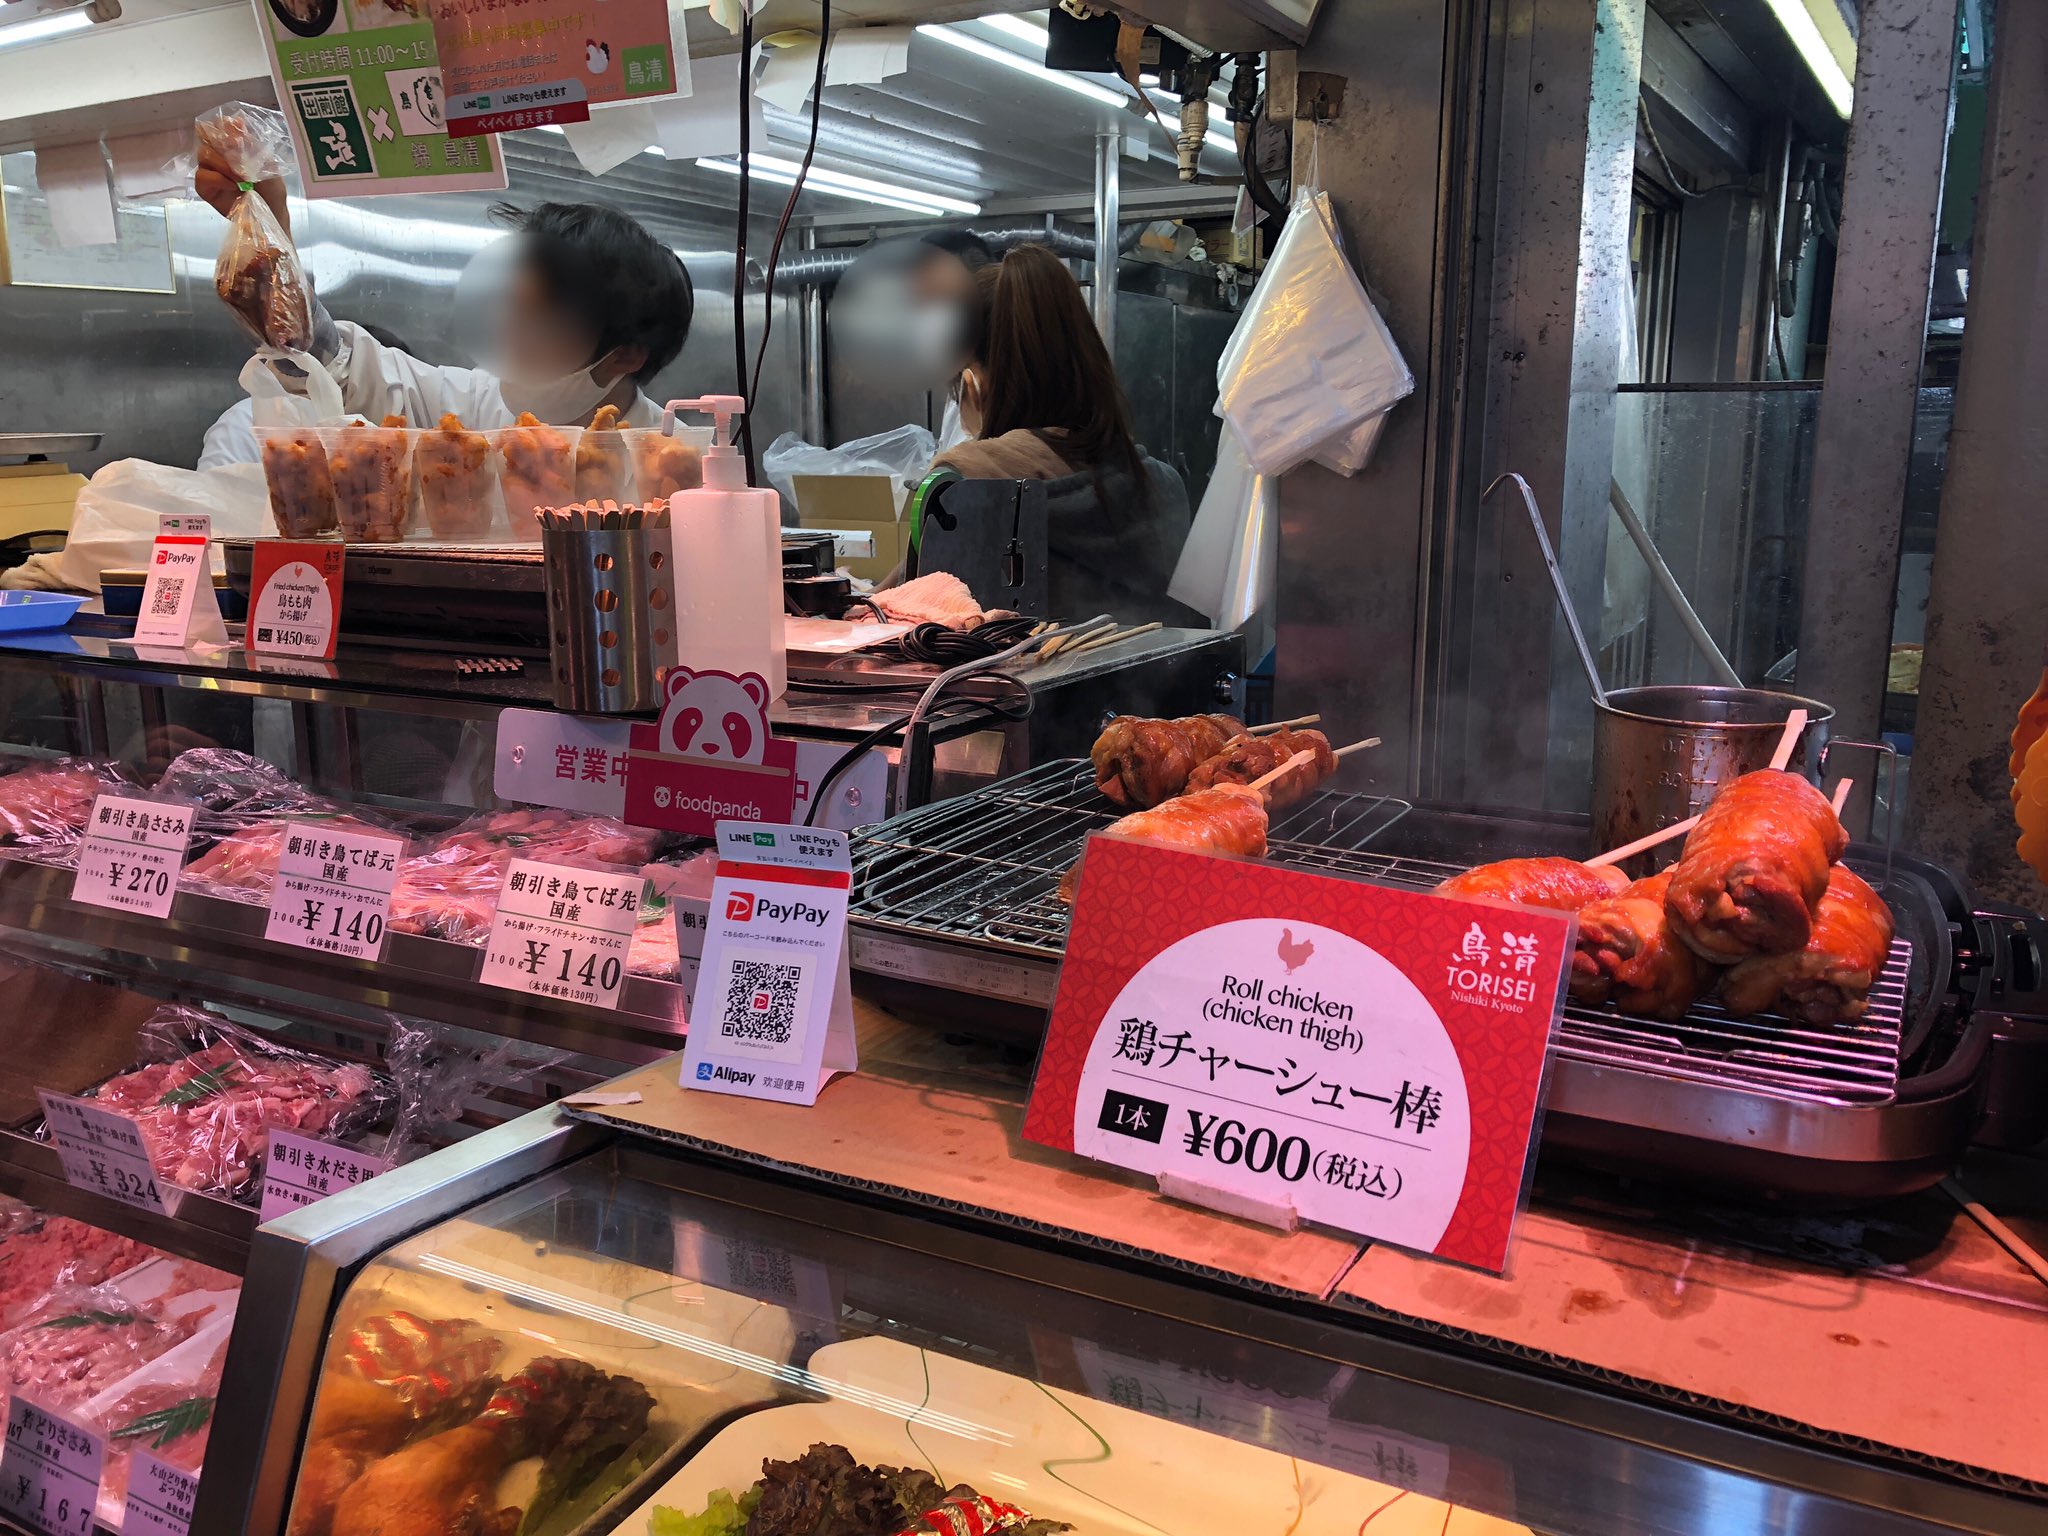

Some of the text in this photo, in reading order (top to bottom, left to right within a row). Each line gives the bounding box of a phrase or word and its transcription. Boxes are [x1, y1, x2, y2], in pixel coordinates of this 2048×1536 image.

[290, 46, 353, 76] 受付時間
[628, 58, 663, 85] 鳥清
[502, 94, 519, 105] LINE
[478, 109, 554, 129] ペイペイ使えます
[168, 552, 196, 565] PayPay
[277, 594, 312, 610] 鳥もも肉
[279, 610, 308, 621] から揚げ
[675, 791, 762, 821] foodpanda
[98, 805, 186, 837] 朝引き鳥ささみ
[131, 831, 148, 842] 国産
[729, 833, 774, 846] LINE Pay
[790, 833, 840, 849] LINE Payも
[287, 835, 395, 872] 朝引き鳥てば元
[798, 845, 834, 858] 使えます
[322, 863, 349, 882] 国産
[509, 871, 637, 912] 朝引き鳥てば先
[549, 900, 582, 922] 国産
[756, 898, 830, 928] PayPay
[1452, 921, 1539, 977] 鳥清
[1446, 965, 1537, 1003] TORISEI
[1222, 974, 1355, 1022] Roll chicken
[1450, 990, 1524, 1014] Nishiki Kyoto
[1201, 996, 1364, 1056] (chicken thigh)
[713, 1065, 756, 1086] Alipay
[762, 1075, 805, 1093] 欢迎使用
[1110, 1016, 1444, 1135] 鶏チャーシュー棒
[1114, 1101, 1153, 1132] 1本
[272, 1142, 375, 1183] 朝引き水だき用
[307, 1173, 329, 1192] 国産
[158, 1482, 192, 1505] ぶつ切り
